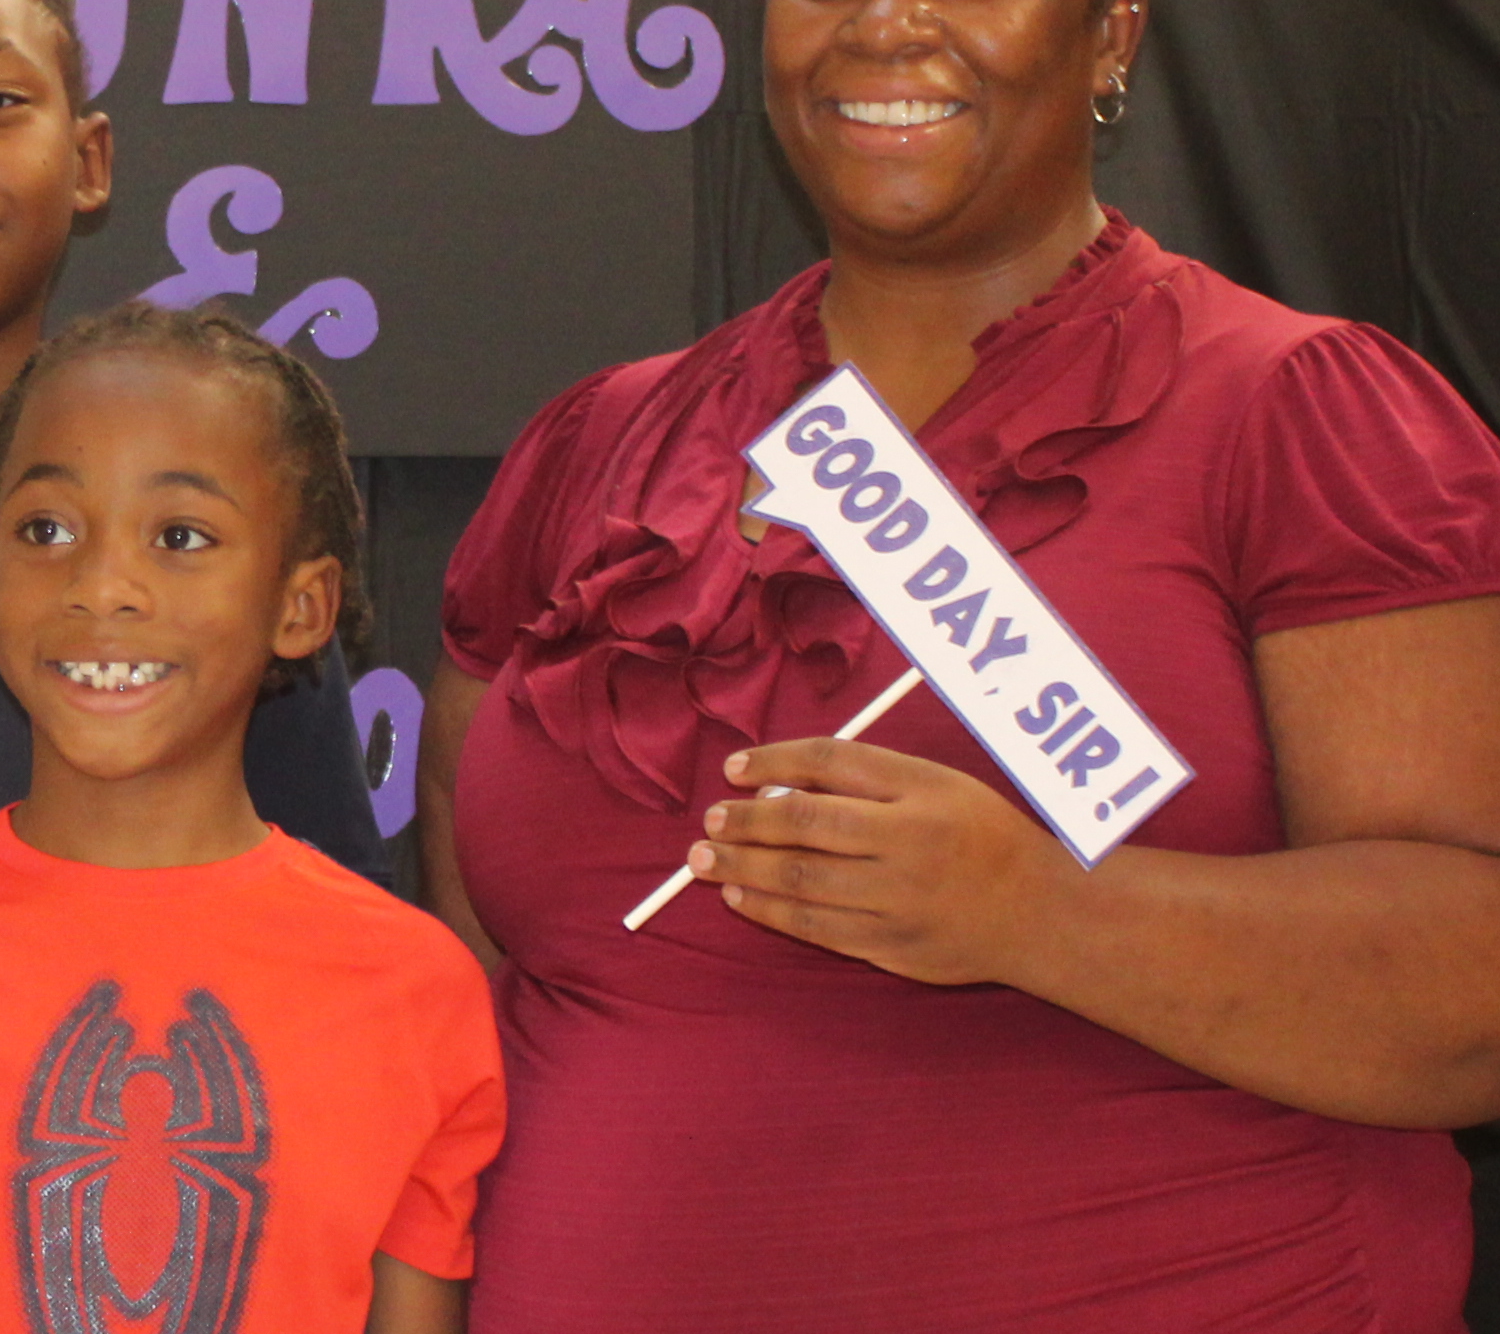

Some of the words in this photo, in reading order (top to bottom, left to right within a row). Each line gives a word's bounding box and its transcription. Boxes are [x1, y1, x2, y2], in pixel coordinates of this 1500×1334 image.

[785, 405, 930, 553] GOOD
[902, 544, 1028, 697] DAY,
[1014, 681, 1161, 822] SIR!
